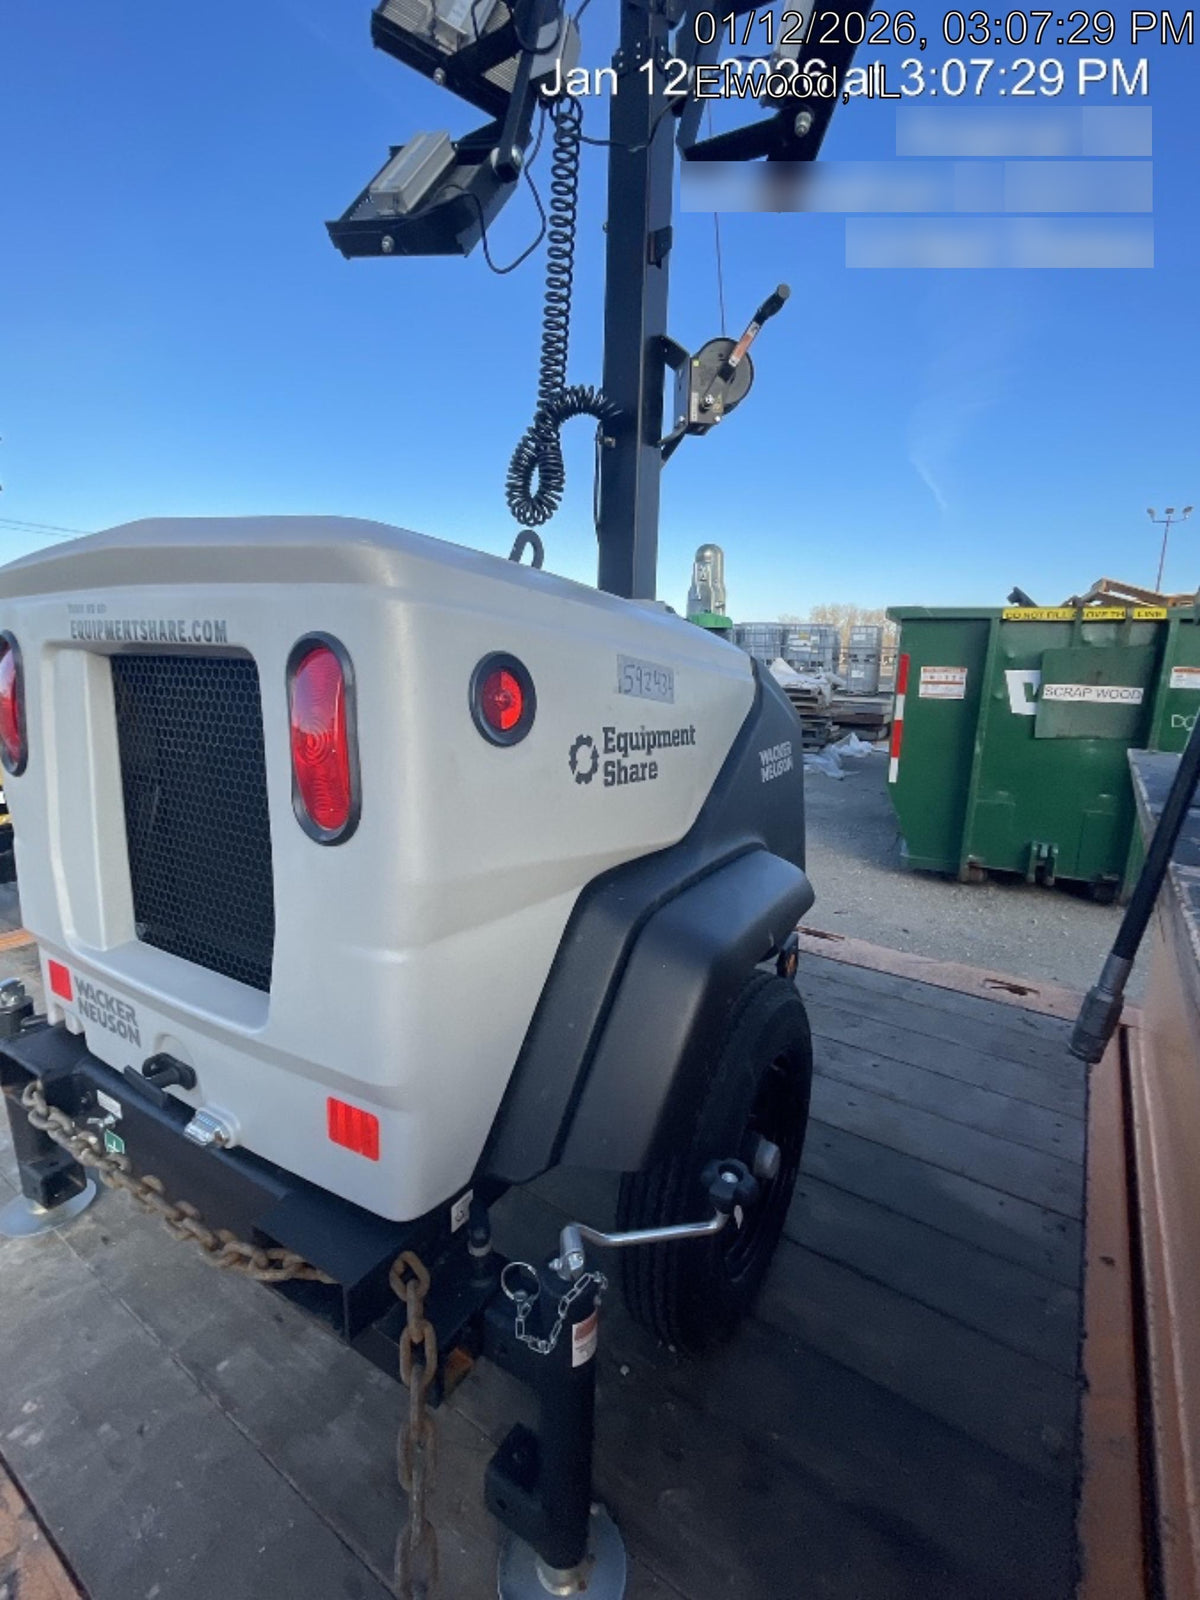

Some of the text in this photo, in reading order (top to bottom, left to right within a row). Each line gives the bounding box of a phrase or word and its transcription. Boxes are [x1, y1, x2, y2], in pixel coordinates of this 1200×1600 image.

[70, 618, 228, 644] EQUIPMENTSHARE.COM
[1044, 685, 1143, 700] SCRAP WOOD
[602, 724, 696, 758] Equipment
[603, 759, 659, 788] Share
[74, 976, 139, 1027] WACKER
[78, 997, 142, 1049] NEUSON
